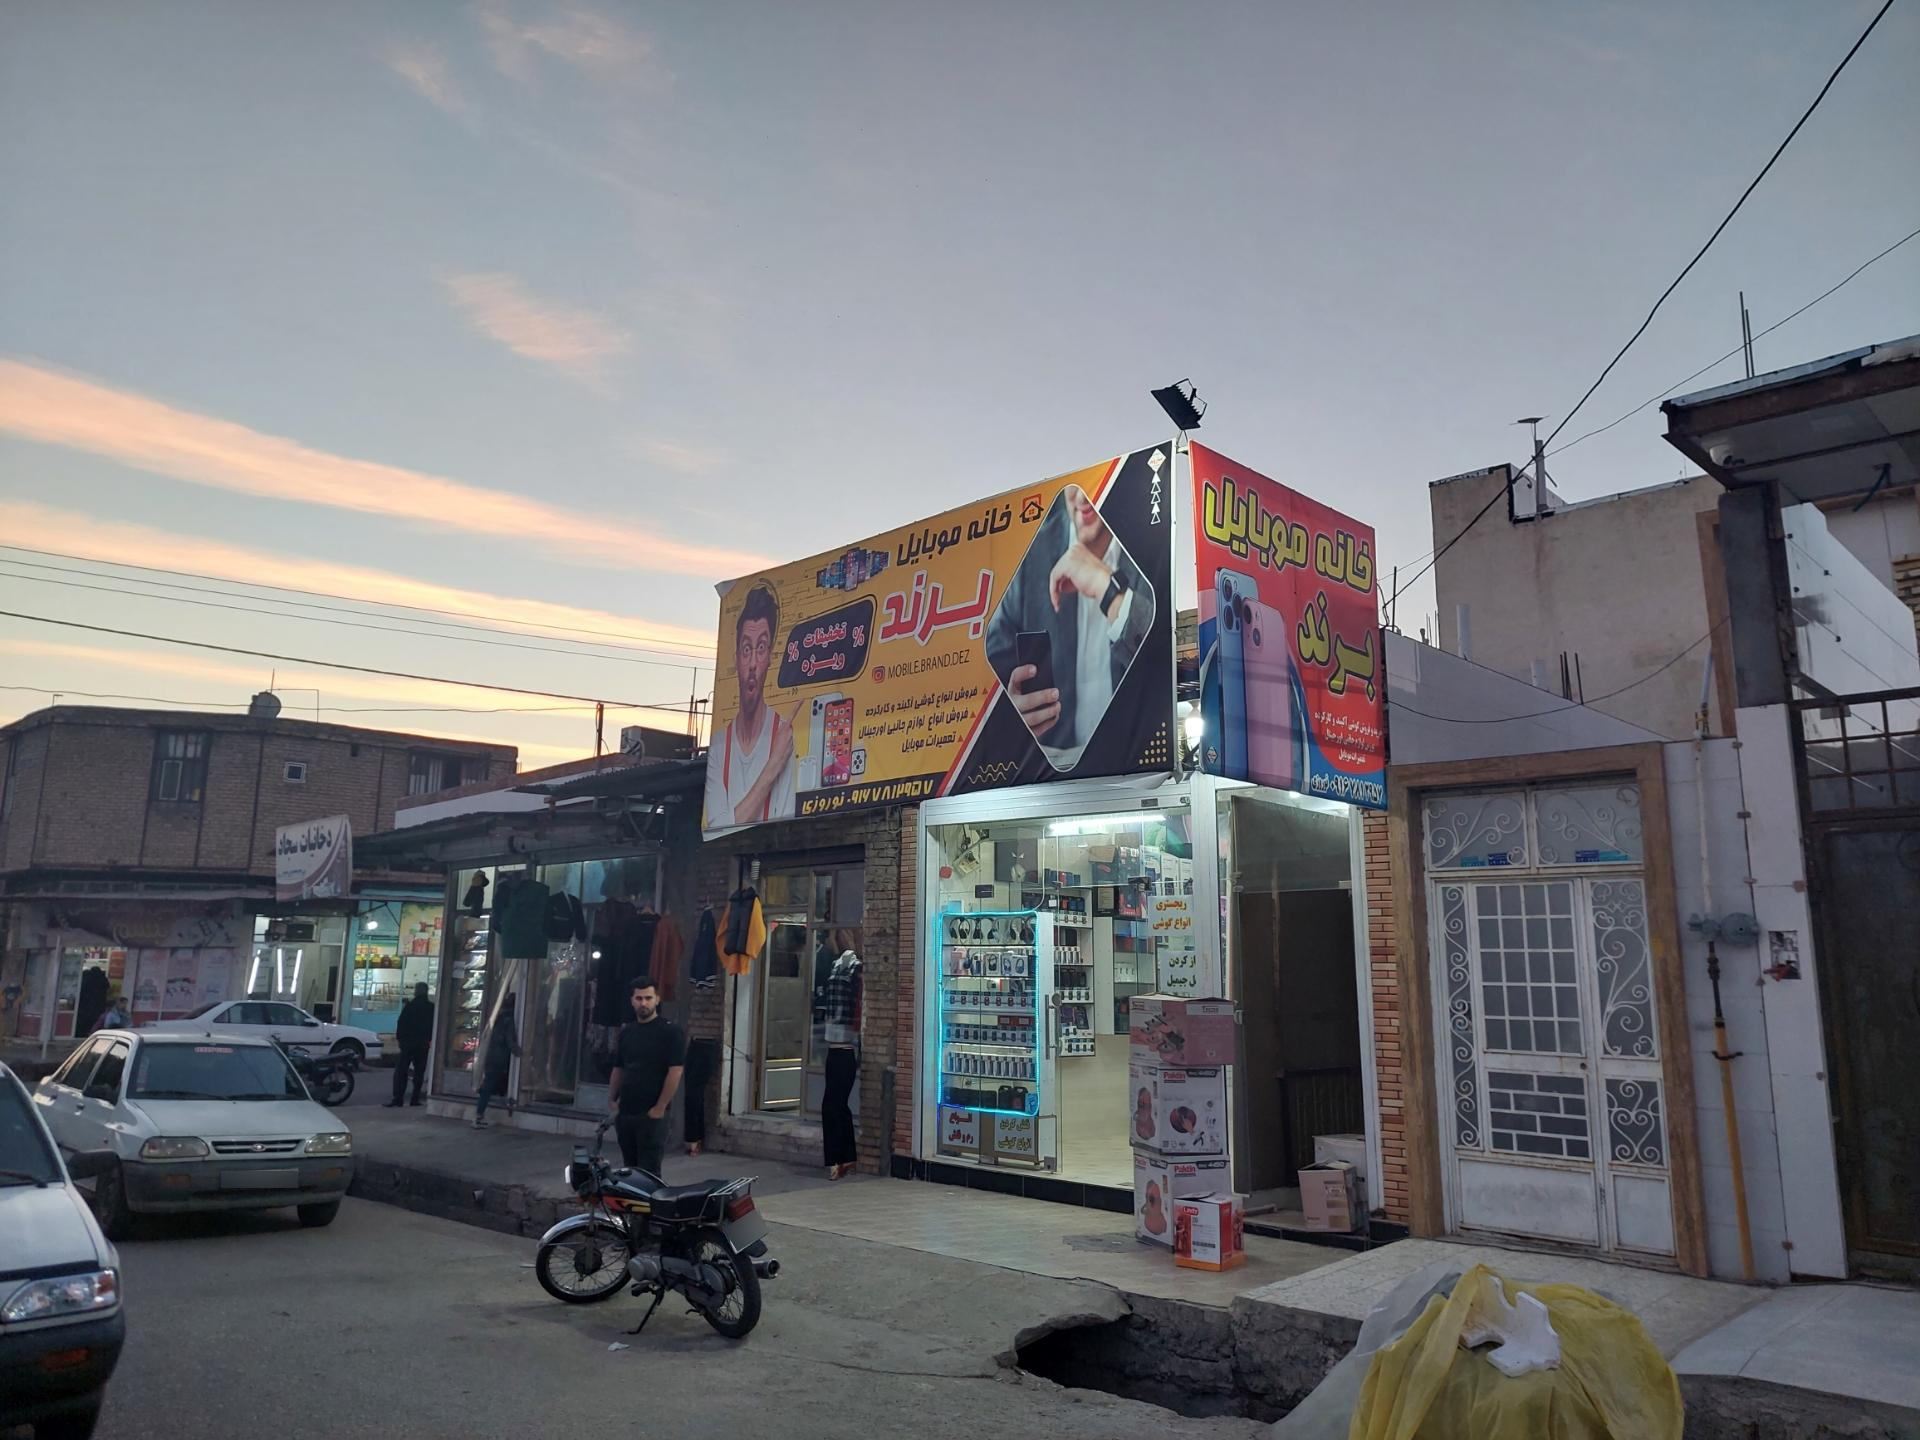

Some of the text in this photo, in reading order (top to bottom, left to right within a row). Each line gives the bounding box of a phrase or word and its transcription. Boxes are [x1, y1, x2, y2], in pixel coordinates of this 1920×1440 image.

[896, 504, 1012, 567] خانه موبایل
[1203, 476, 1373, 594] خانه موبایل
[878, 568, 995, 647] برند
[803, 621, 847, 648] تخفیفات
[1297, 590, 1376, 702] برند
[801, 652, 845, 676] ویژه
[887, 649, 970, 679] MOBILE.BRAND.DEZ
[936, 690, 954, 708] انواع
[954, 686, 978, 701] فروش
[891, 705, 896, 713] و
[858, 707, 969, 740] فروش انواع لوازم جانبی اورجینال
[901, 731, 957, 753] تعمیرات موبایل
[801, 792, 845, 815] نوروزی
[278, 824, 333, 861] دخانیات سجاد
[1155, 899, 1187, 912] ریجستری
[1152, 917, 1191, 930] انواع گوشی
[1168, 955, 1188, 968] کردن
[1166, 974, 1188, 987] جیمیل
